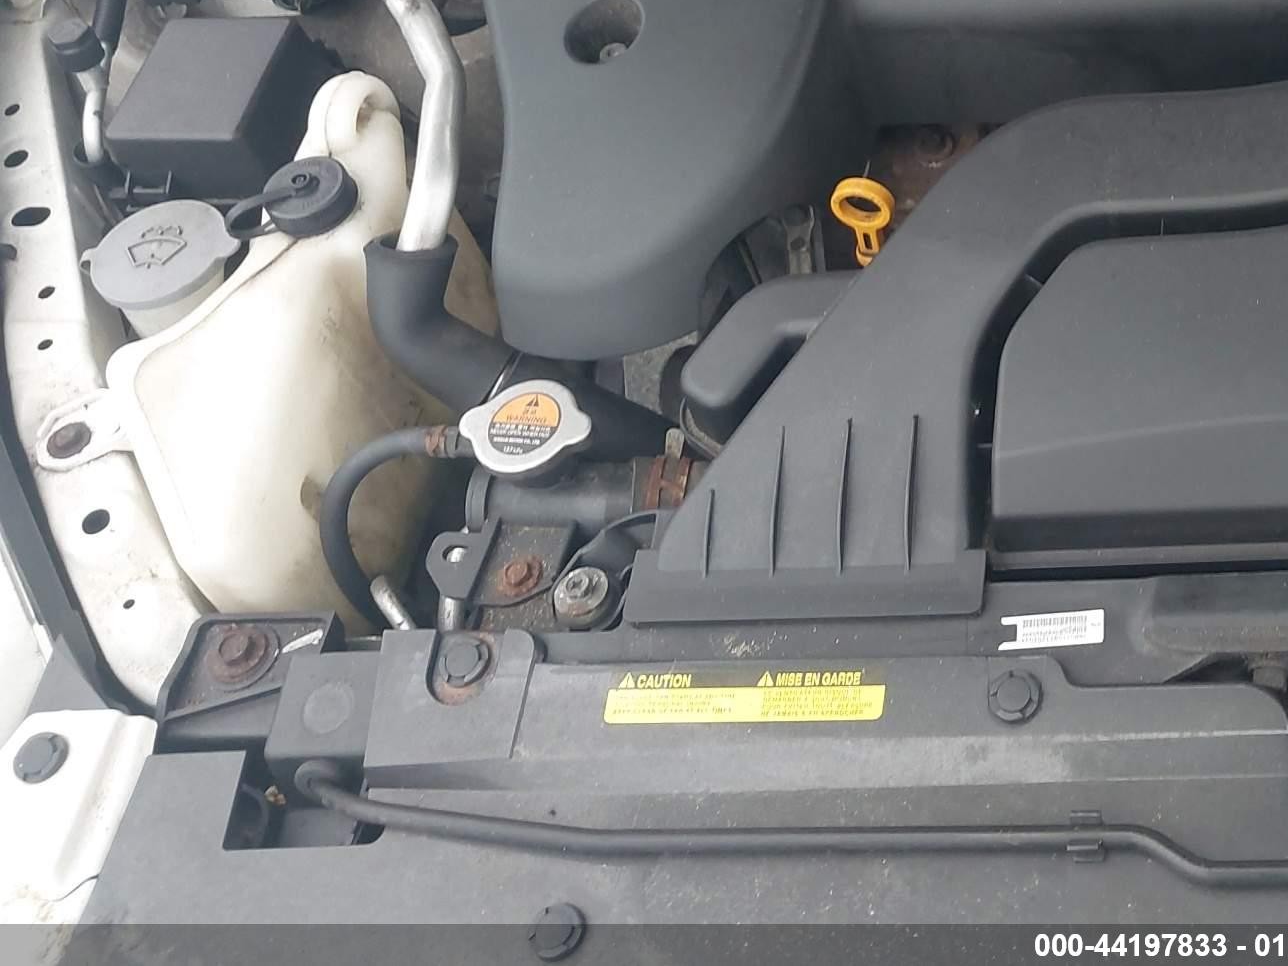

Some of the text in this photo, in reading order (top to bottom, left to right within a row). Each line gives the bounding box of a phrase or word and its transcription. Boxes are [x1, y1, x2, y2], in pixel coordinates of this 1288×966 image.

[506, 415, 547, 423] WARNING
[637, 674, 692, 688] CAUTION
[775, 671, 862, 687] MISE EN GARDE
